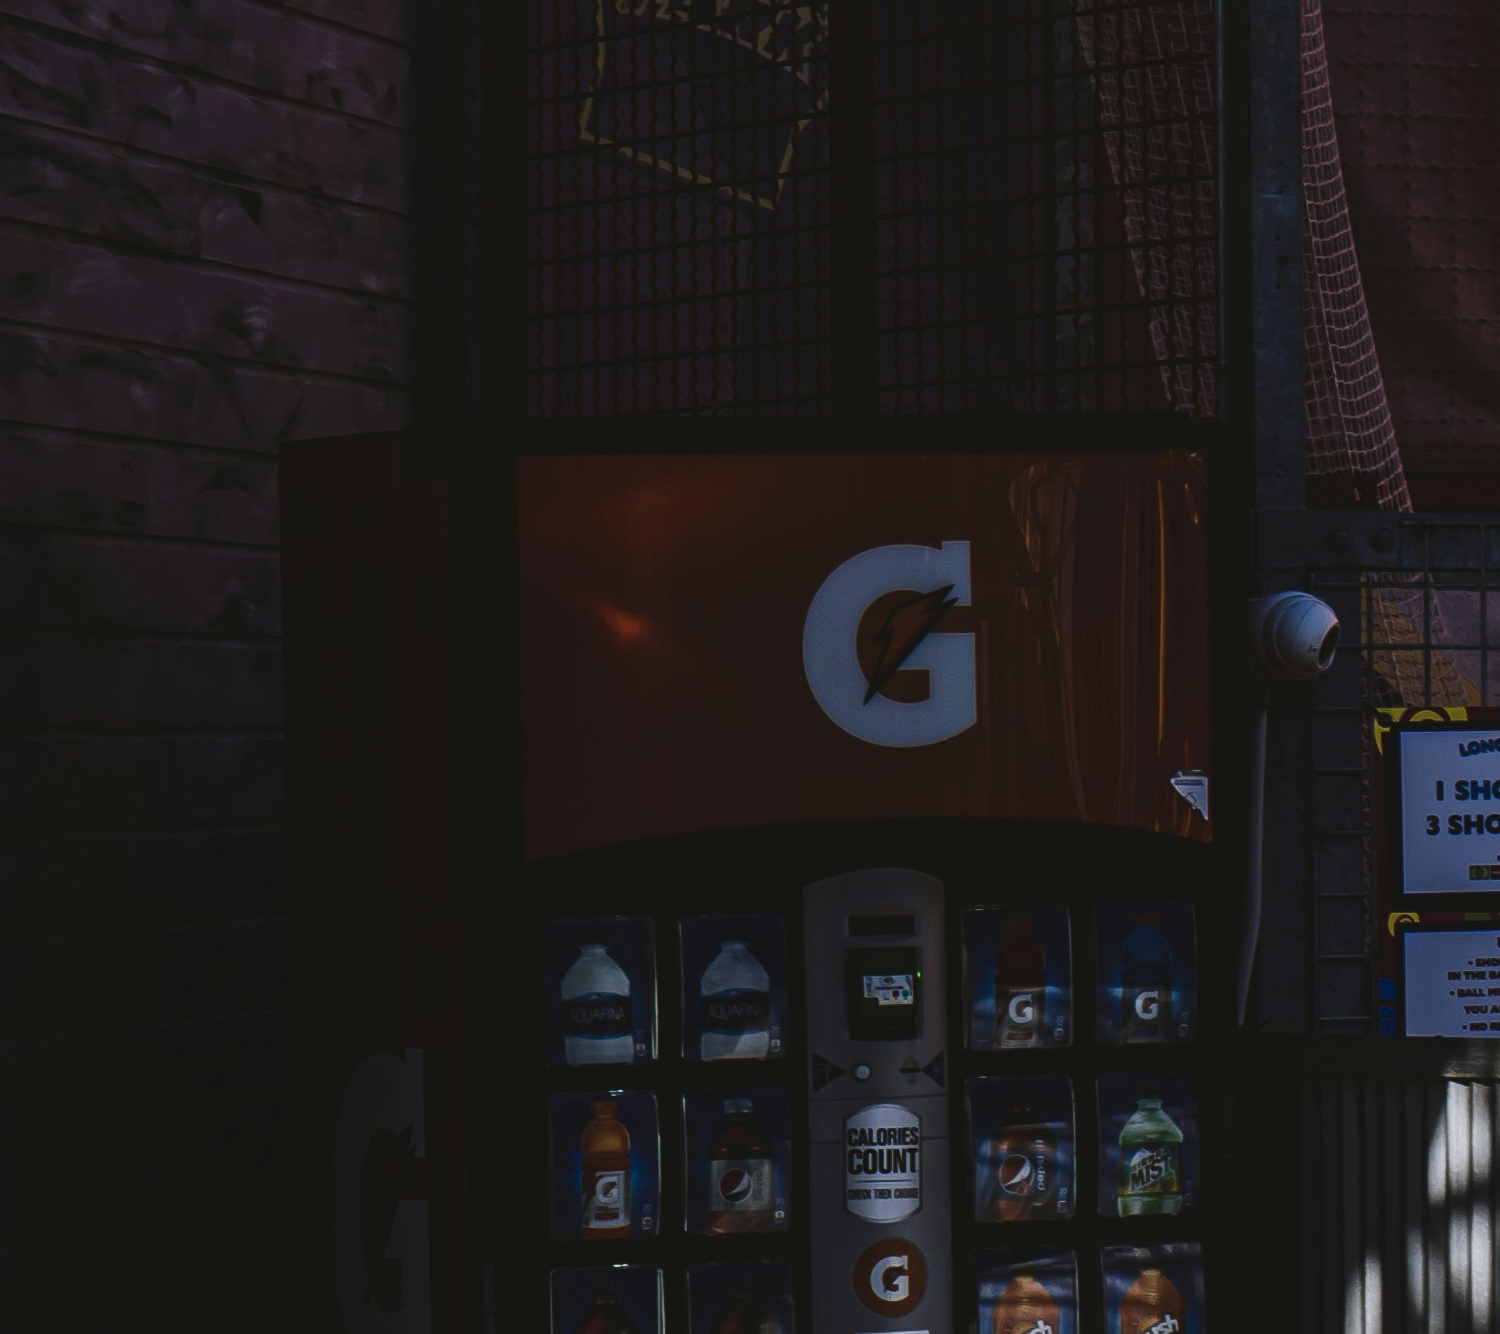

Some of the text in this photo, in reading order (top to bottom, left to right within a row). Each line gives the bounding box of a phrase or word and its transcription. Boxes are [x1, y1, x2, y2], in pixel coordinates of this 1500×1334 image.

[803, 541, 977, 748] G
[1426, 814, 1440, 836] 3
[1447, 971, 1462, 981] IN
[1463, 970, 1486, 981] THE
[1008, 993, 1034, 1024] G
[1135, 990, 1160, 1020] G
[1463, 1005, 1488, 1015] YOU
[1469, 1022, 1488, 1032] NO
[848, 1126, 919, 1146] CALORIES
[848, 1148, 918, 1175] COUNT
[870, 1254, 909, 1302] G
